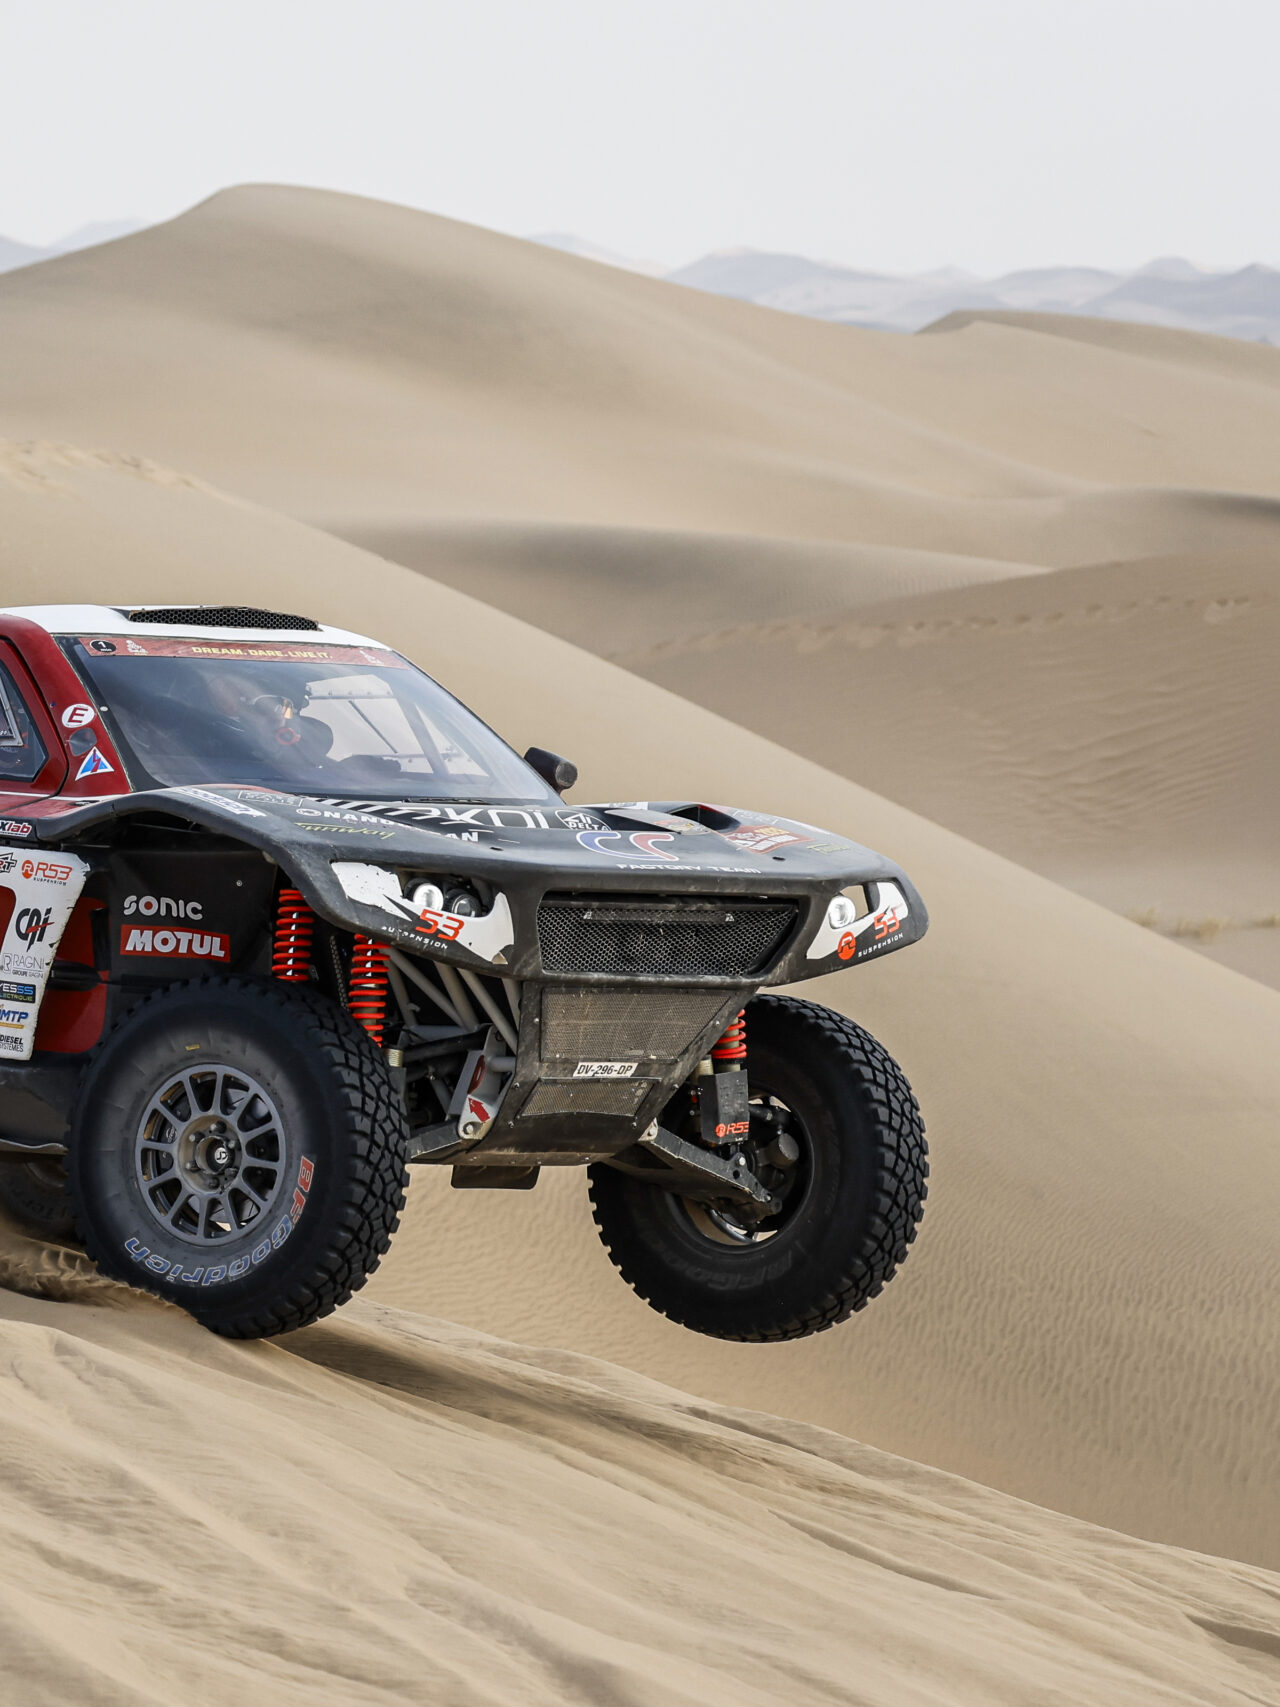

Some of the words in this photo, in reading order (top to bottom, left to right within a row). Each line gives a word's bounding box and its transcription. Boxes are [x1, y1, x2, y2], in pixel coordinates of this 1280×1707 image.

[191, 646, 246, 656] DREAM.
[250, 648, 289, 658] DARE.
[290, 650, 318, 659] LIVE
[318, 651, 333, 660] IT.
[706, 865, 763, 875] TEAM
[125, 928, 226, 958] MOTUL
[857, 932, 904, 958] SUSPENSION
[12, 954, 45, 970] RAGNI
[0, 1033, 24, 1046] DIESEL
[577, 1063, 634, 1076] DV-296-DP
[123, 1154, 316, 1287] BFGoodrich
